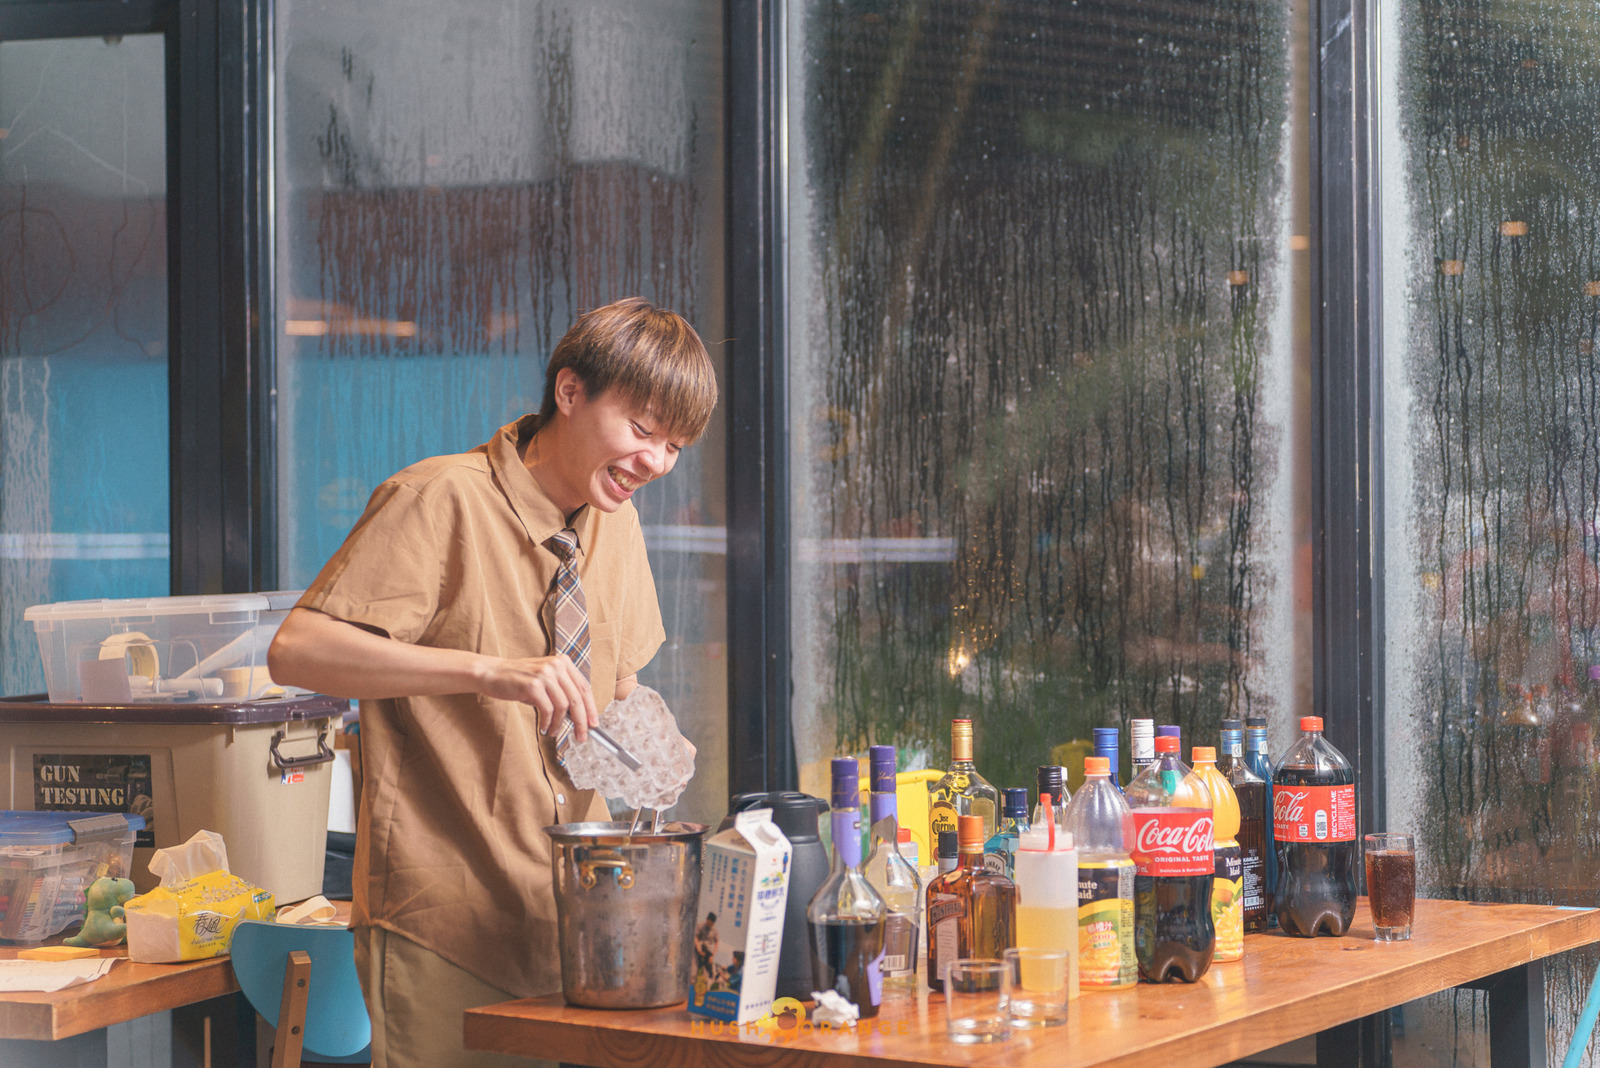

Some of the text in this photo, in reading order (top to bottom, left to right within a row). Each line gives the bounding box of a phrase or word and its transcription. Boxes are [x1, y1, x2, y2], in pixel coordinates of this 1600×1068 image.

[40, 765, 81, 783] GUN
[41, 787, 125, 806] TESTING
[1331, 790, 1337, 802] ME
[1192, 854, 1209, 862] TASTE
[1078, 889, 1092, 899] aid
